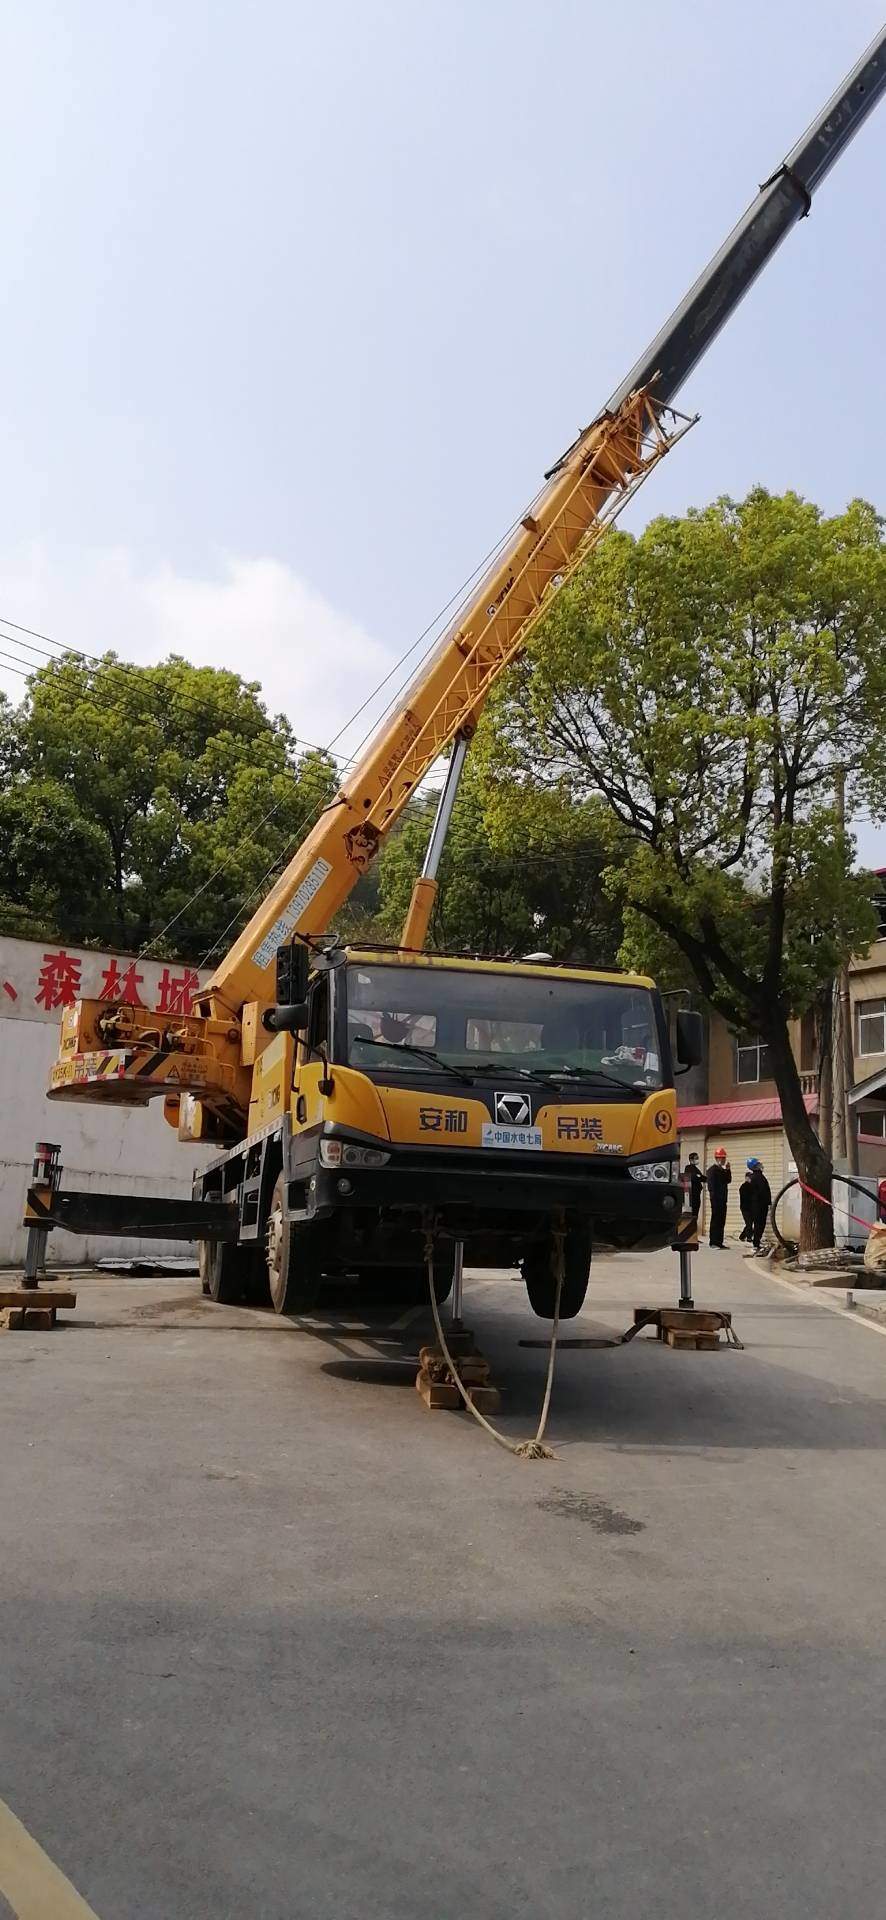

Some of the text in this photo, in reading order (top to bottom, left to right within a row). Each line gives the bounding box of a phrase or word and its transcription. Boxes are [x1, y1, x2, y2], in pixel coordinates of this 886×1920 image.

[419, 1107, 603, 1140] 安和 吊装
[494, 1130, 541, 1145] 中国水电七局
